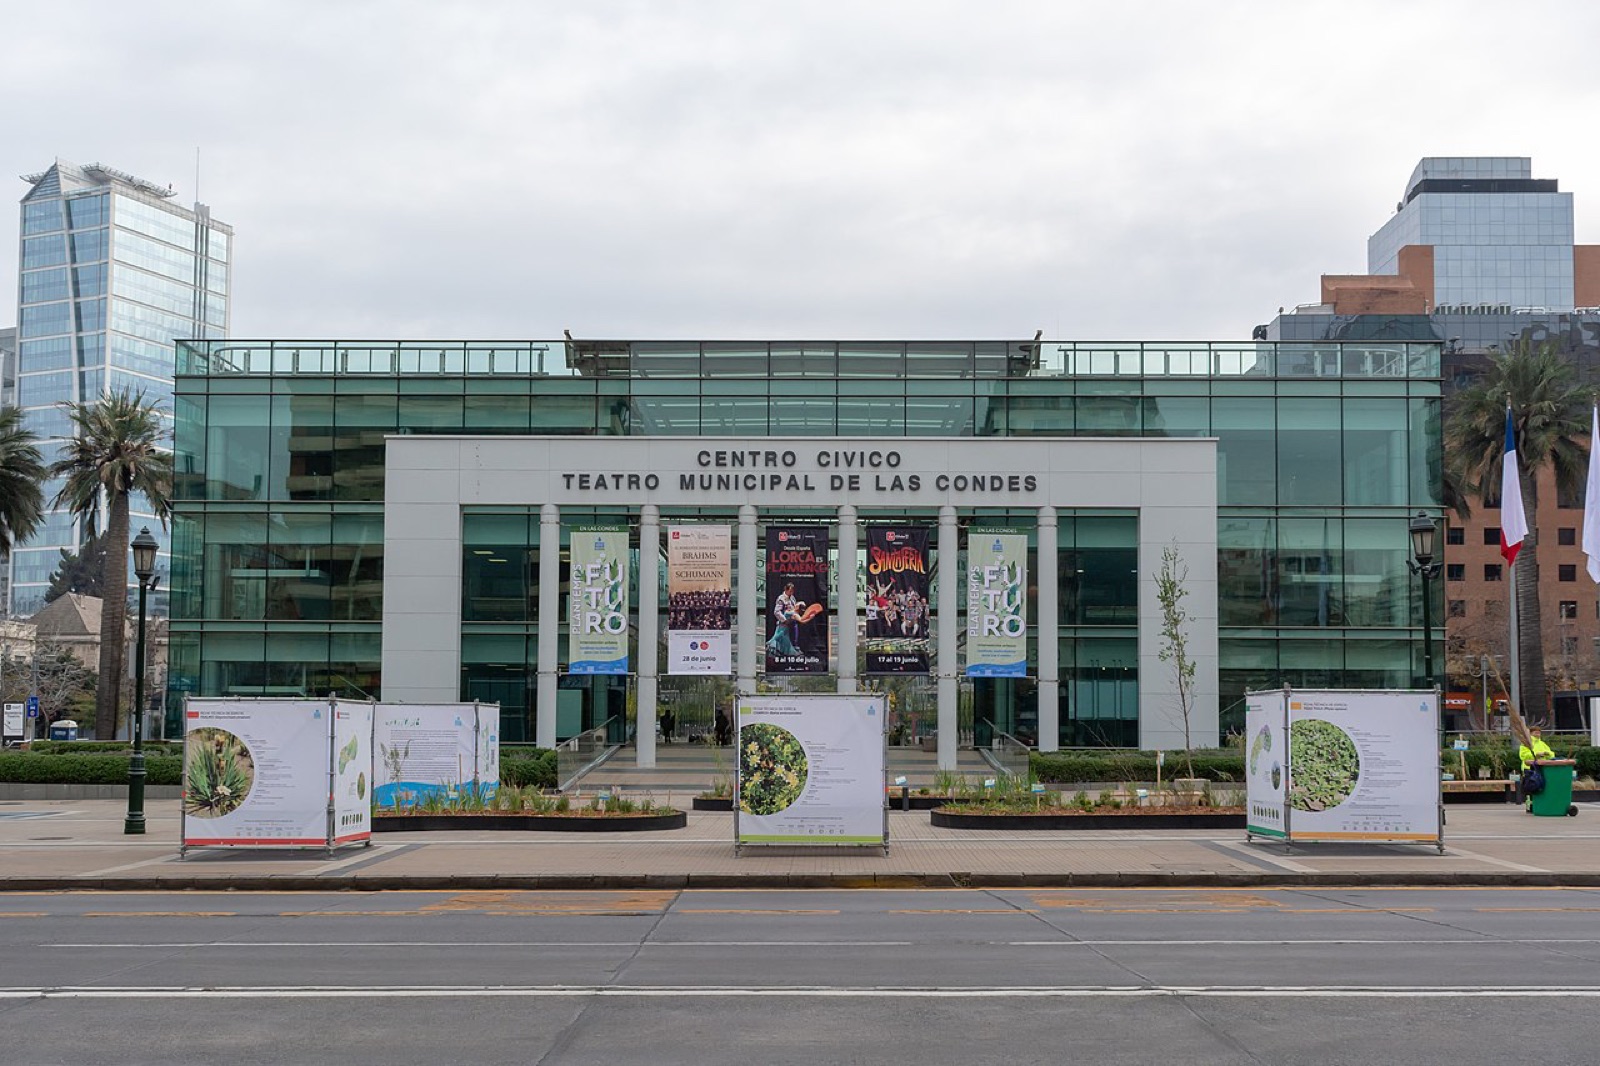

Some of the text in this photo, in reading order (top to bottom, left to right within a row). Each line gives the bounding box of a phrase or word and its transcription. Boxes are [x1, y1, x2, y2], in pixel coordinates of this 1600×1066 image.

[697, 450, 901, 467] CENTRO CIVICO
[562, 473, 1037, 491] TEATRO MUNICIPAL DE LAS CONDES
[771, 551, 815, 563] LORCA
[675, 570, 724, 578] SCHUMANN
[572, 564, 581, 635] PLANTEMOS
[969, 565, 980, 637] PLANTEMOS
[804, 656, 819, 664] julio
[901, 656, 919, 664] junio
